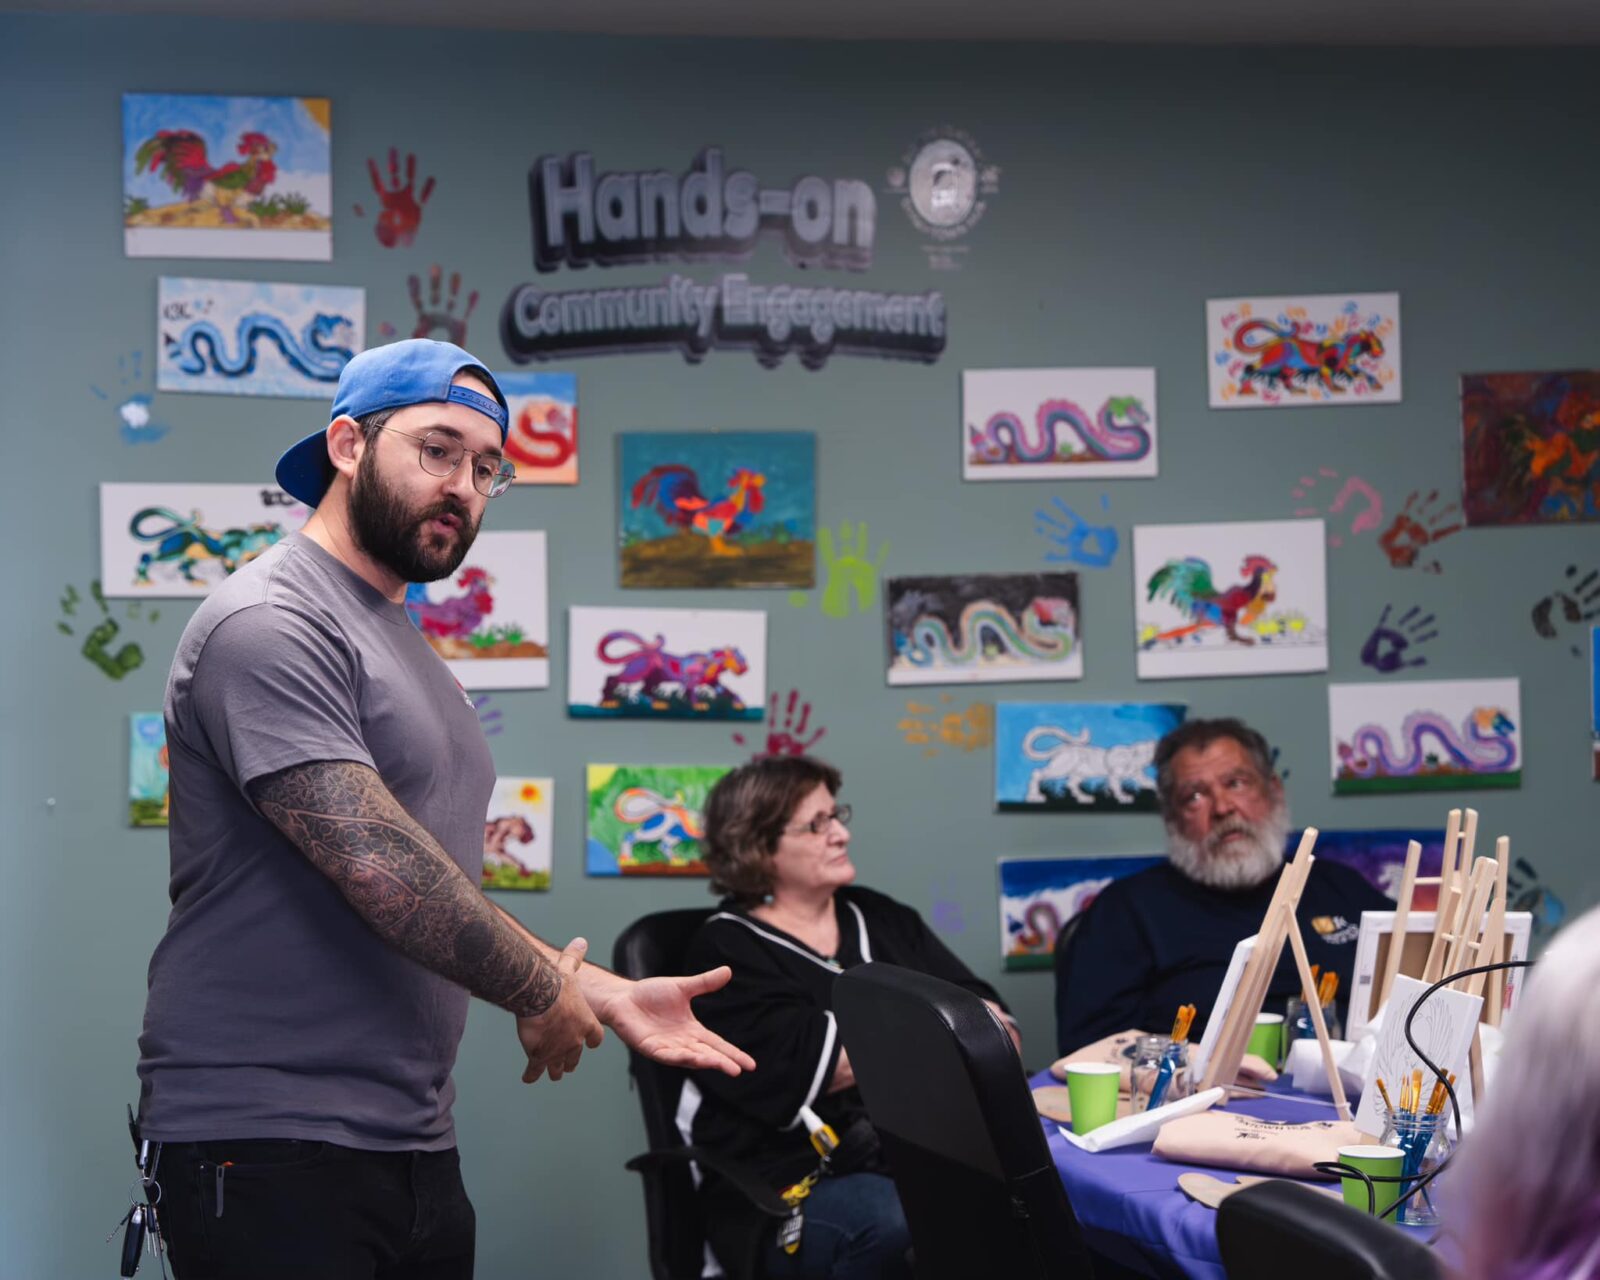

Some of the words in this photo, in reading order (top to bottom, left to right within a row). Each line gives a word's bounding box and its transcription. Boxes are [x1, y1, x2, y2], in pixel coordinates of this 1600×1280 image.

[532, 148, 877, 263] Hands-on
[504, 275, 720, 352] Community
[721, 273, 947, 355] Engagement
